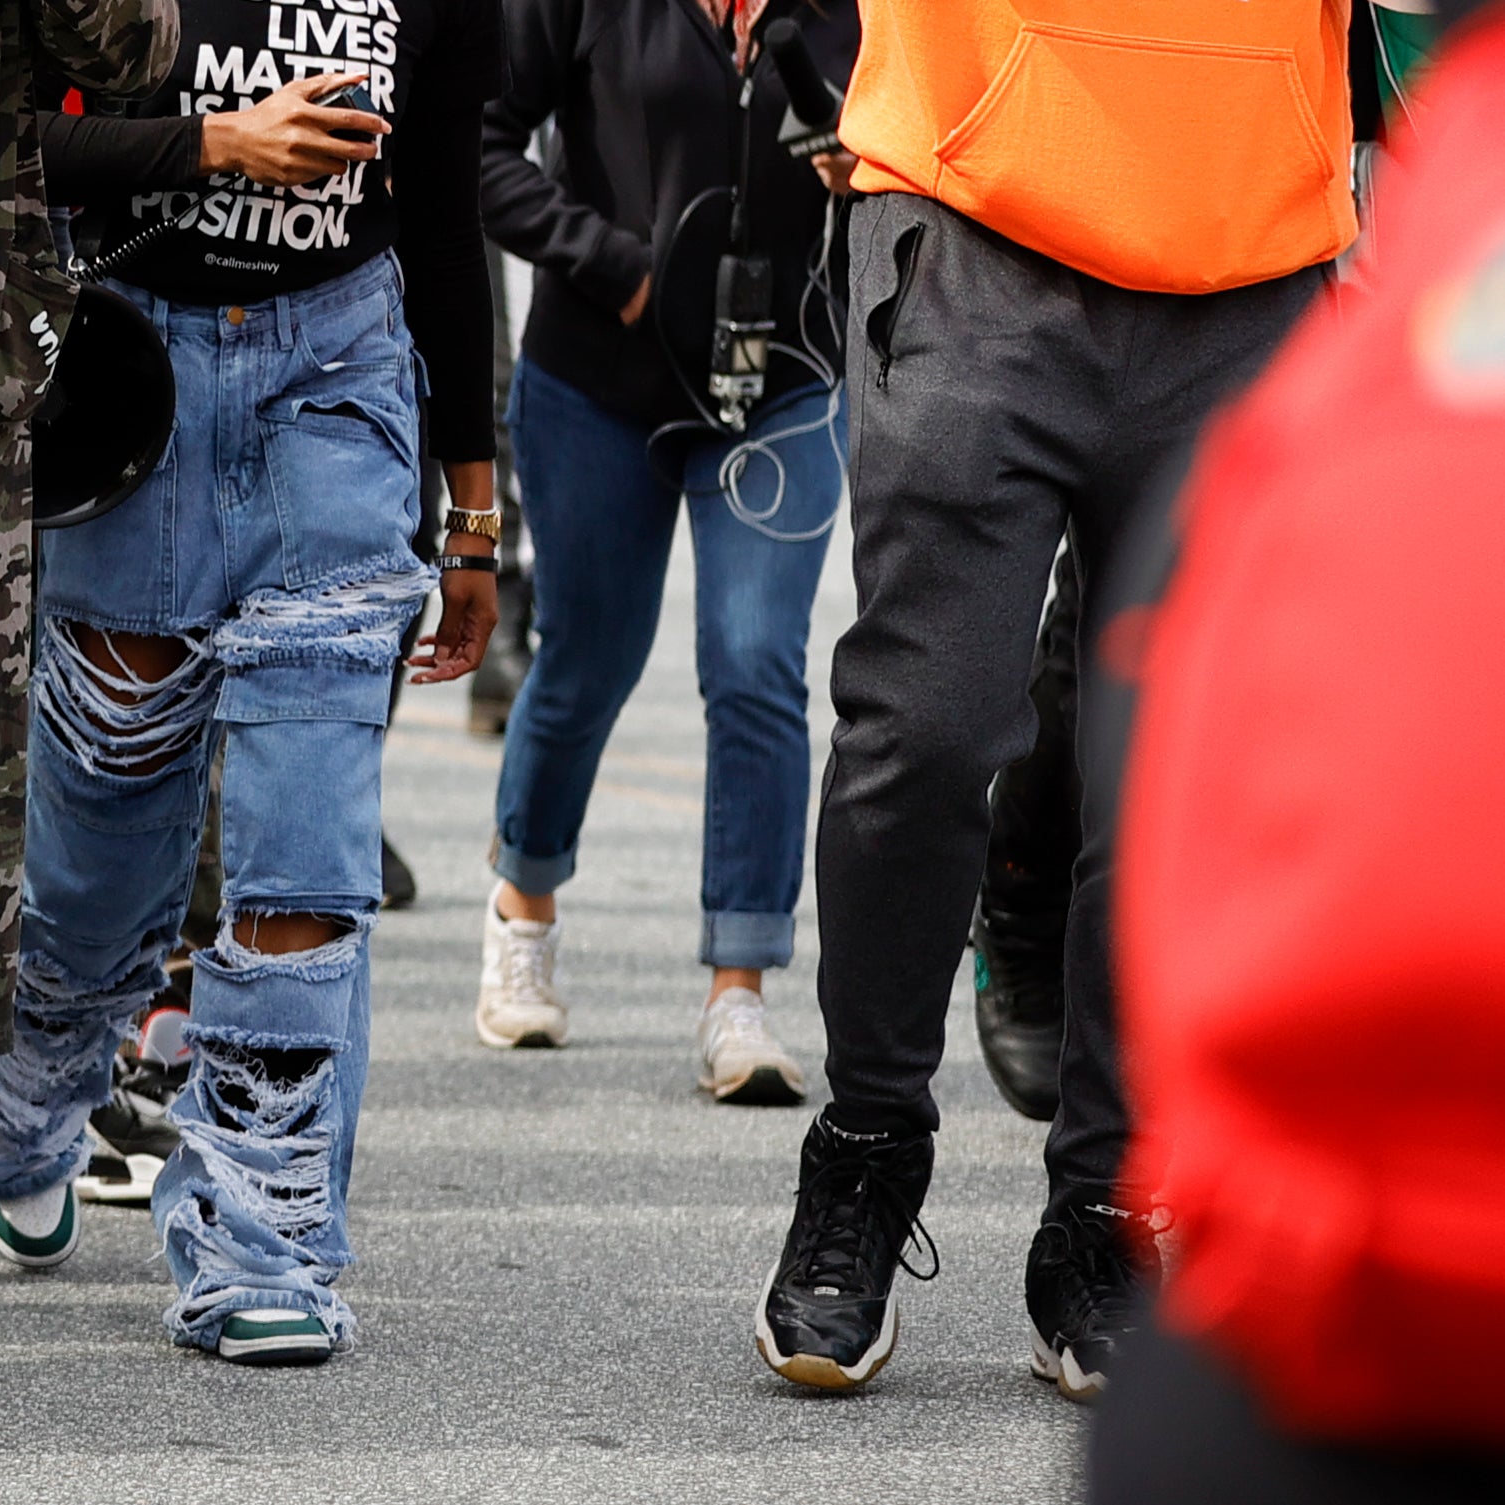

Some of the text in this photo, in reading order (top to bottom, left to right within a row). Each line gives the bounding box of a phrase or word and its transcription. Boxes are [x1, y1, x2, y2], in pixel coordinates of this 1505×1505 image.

[267, 4, 398, 66] LIVES
[131, 190, 351, 252] POSITION.
[204, 252, 280, 275] @callmeshivy
